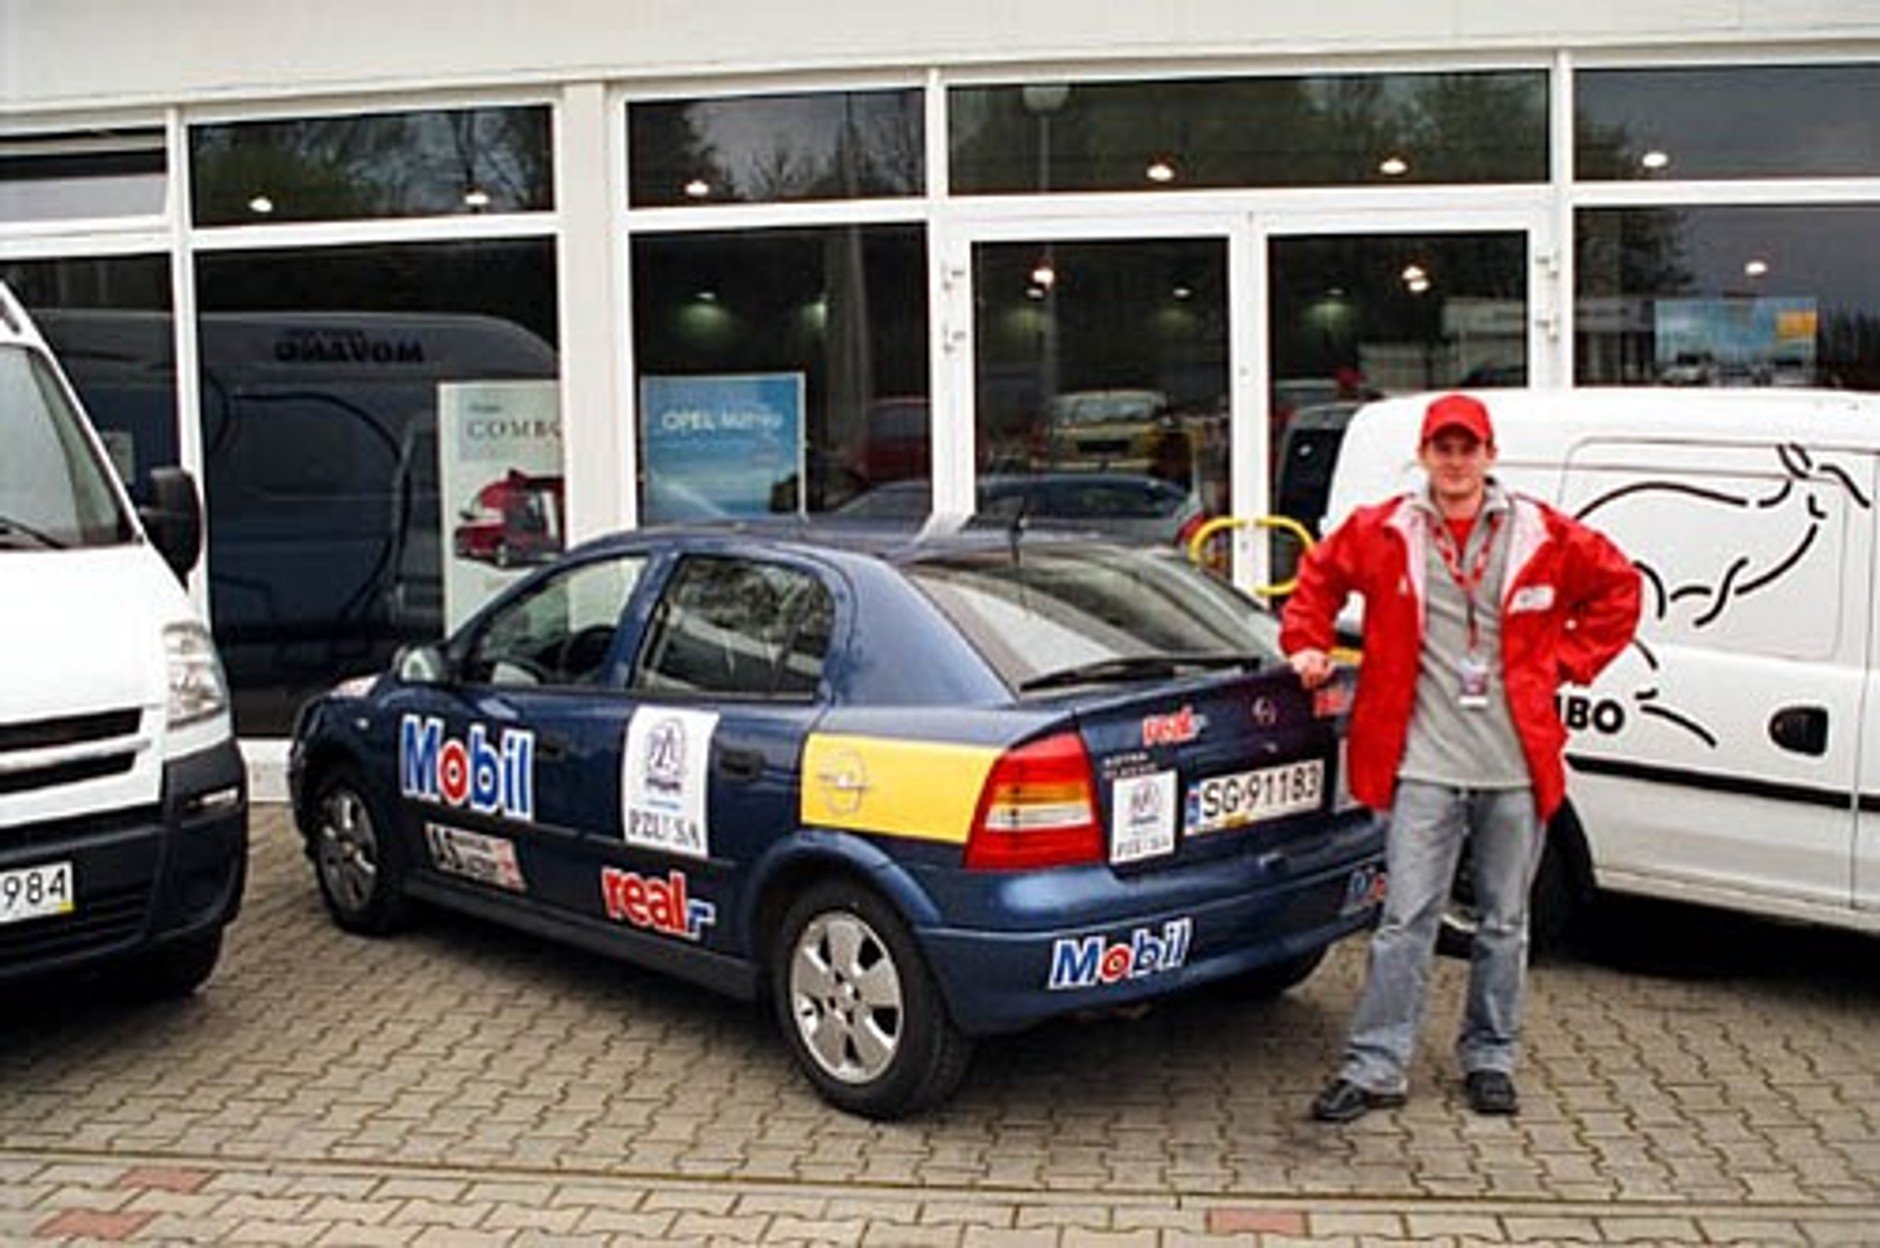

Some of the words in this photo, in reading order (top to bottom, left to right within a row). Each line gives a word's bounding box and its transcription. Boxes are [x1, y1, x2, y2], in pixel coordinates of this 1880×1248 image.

[401, 713, 535, 821] Mobil
[3, 867, 66, 910] 984
[1049, 916, 1192, 989] Mobil
